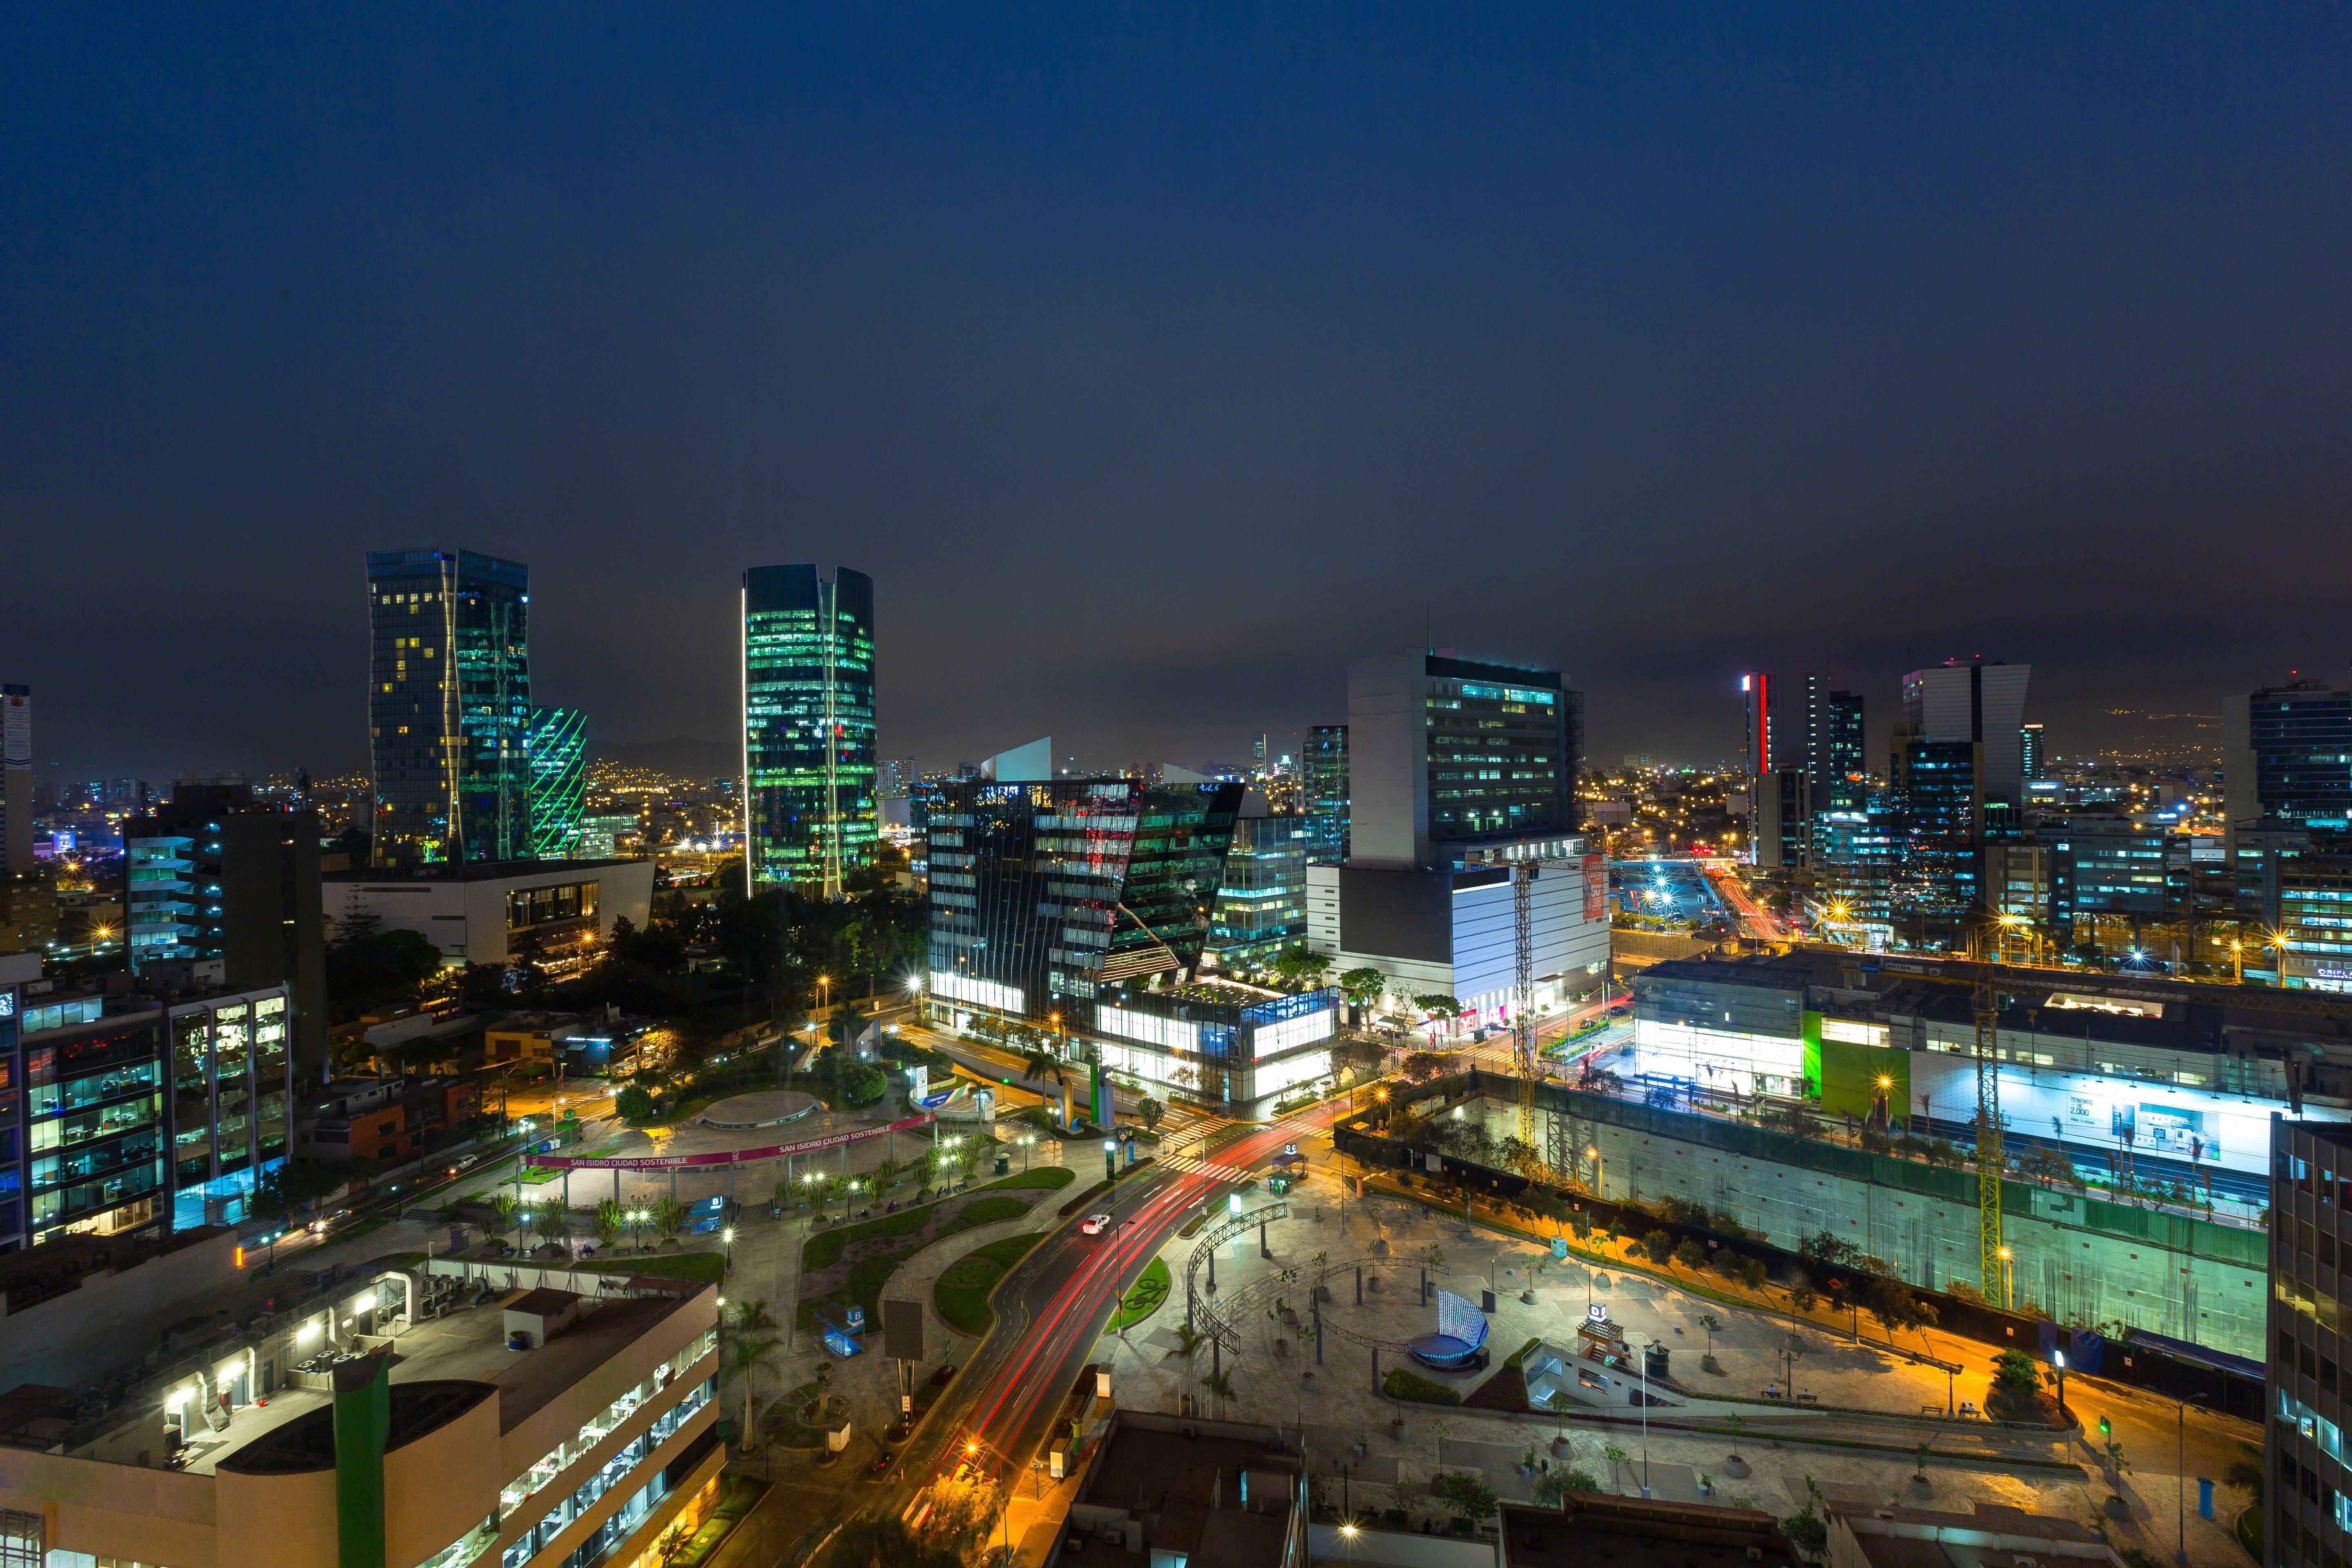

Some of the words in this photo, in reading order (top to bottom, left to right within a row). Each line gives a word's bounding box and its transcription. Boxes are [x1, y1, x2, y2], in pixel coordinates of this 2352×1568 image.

[2070, 1097, 2093, 1105] TENEMOS
[797, 1140, 822, 1150] ISIDRO
[823, 1134, 849, 1145] CIUDAD
[850, 1125, 891, 1140] SOSTENIBLE
[640, 1156, 688, 1166] SOSTENIBLE
[855, 1311, 861, 1320] B
[1591, 1306, 1599, 1316] D
